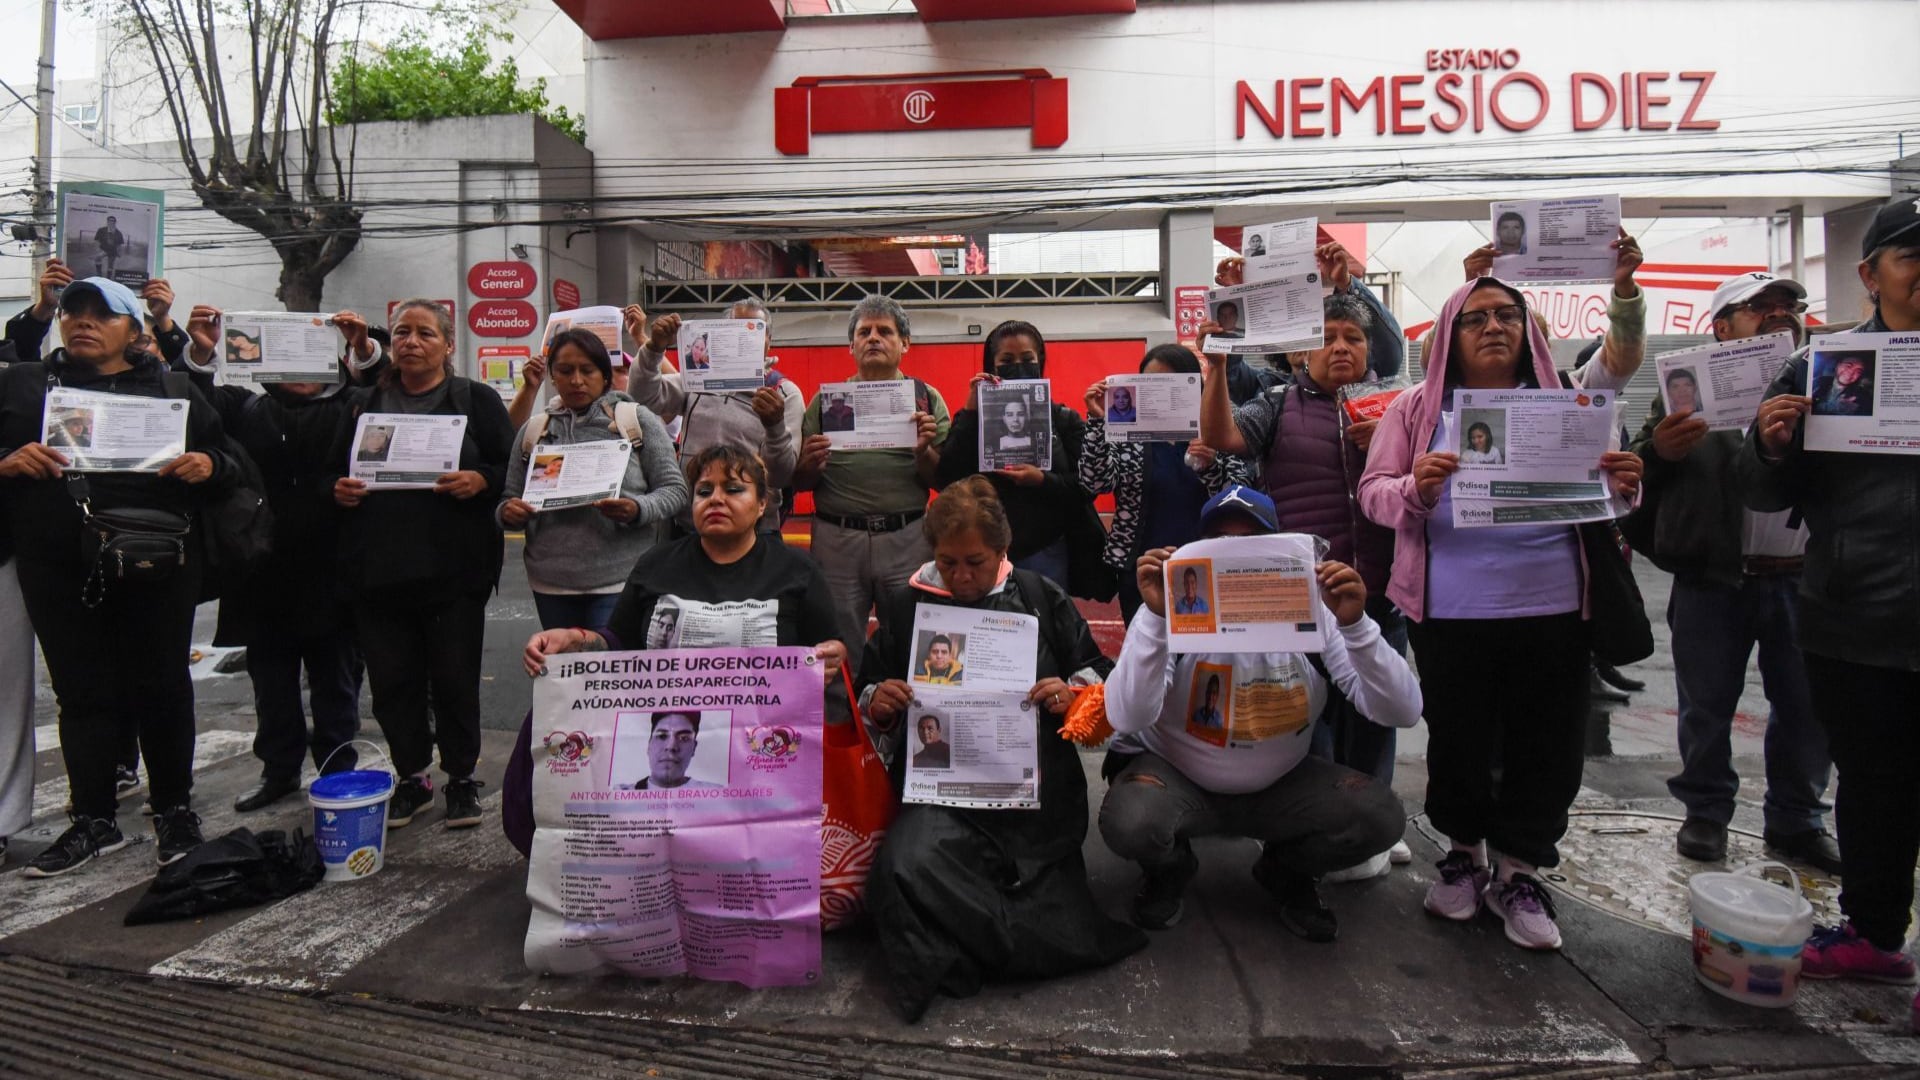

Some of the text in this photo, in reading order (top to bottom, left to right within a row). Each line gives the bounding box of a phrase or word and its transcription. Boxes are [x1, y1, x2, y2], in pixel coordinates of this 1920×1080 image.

[1426, 48, 1520, 71] ESTADIO
[1236, 71, 1720, 139] NEMESIO DIEZ
[487, 268, 517, 276] Acceso
[480, 279, 524, 289] General
[487, 307, 518, 315] Acceso
[475, 318, 530, 328] Abonados
[1889, 337, 1920, 345] ¡HASTA
[560, 656, 798, 678] ¡¡BOLETÍN DE URGENCIA!!
[584, 676, 772, 691] PERSONA DESAPARECIDA,
[572, 694, 782, 710] AYÚDANOS A ENCONTRARLA
[570, 788, 773, 801] ANTONY EMMANUEL BRAVO SOLARES
[316, 839, 348, 848] REMA
